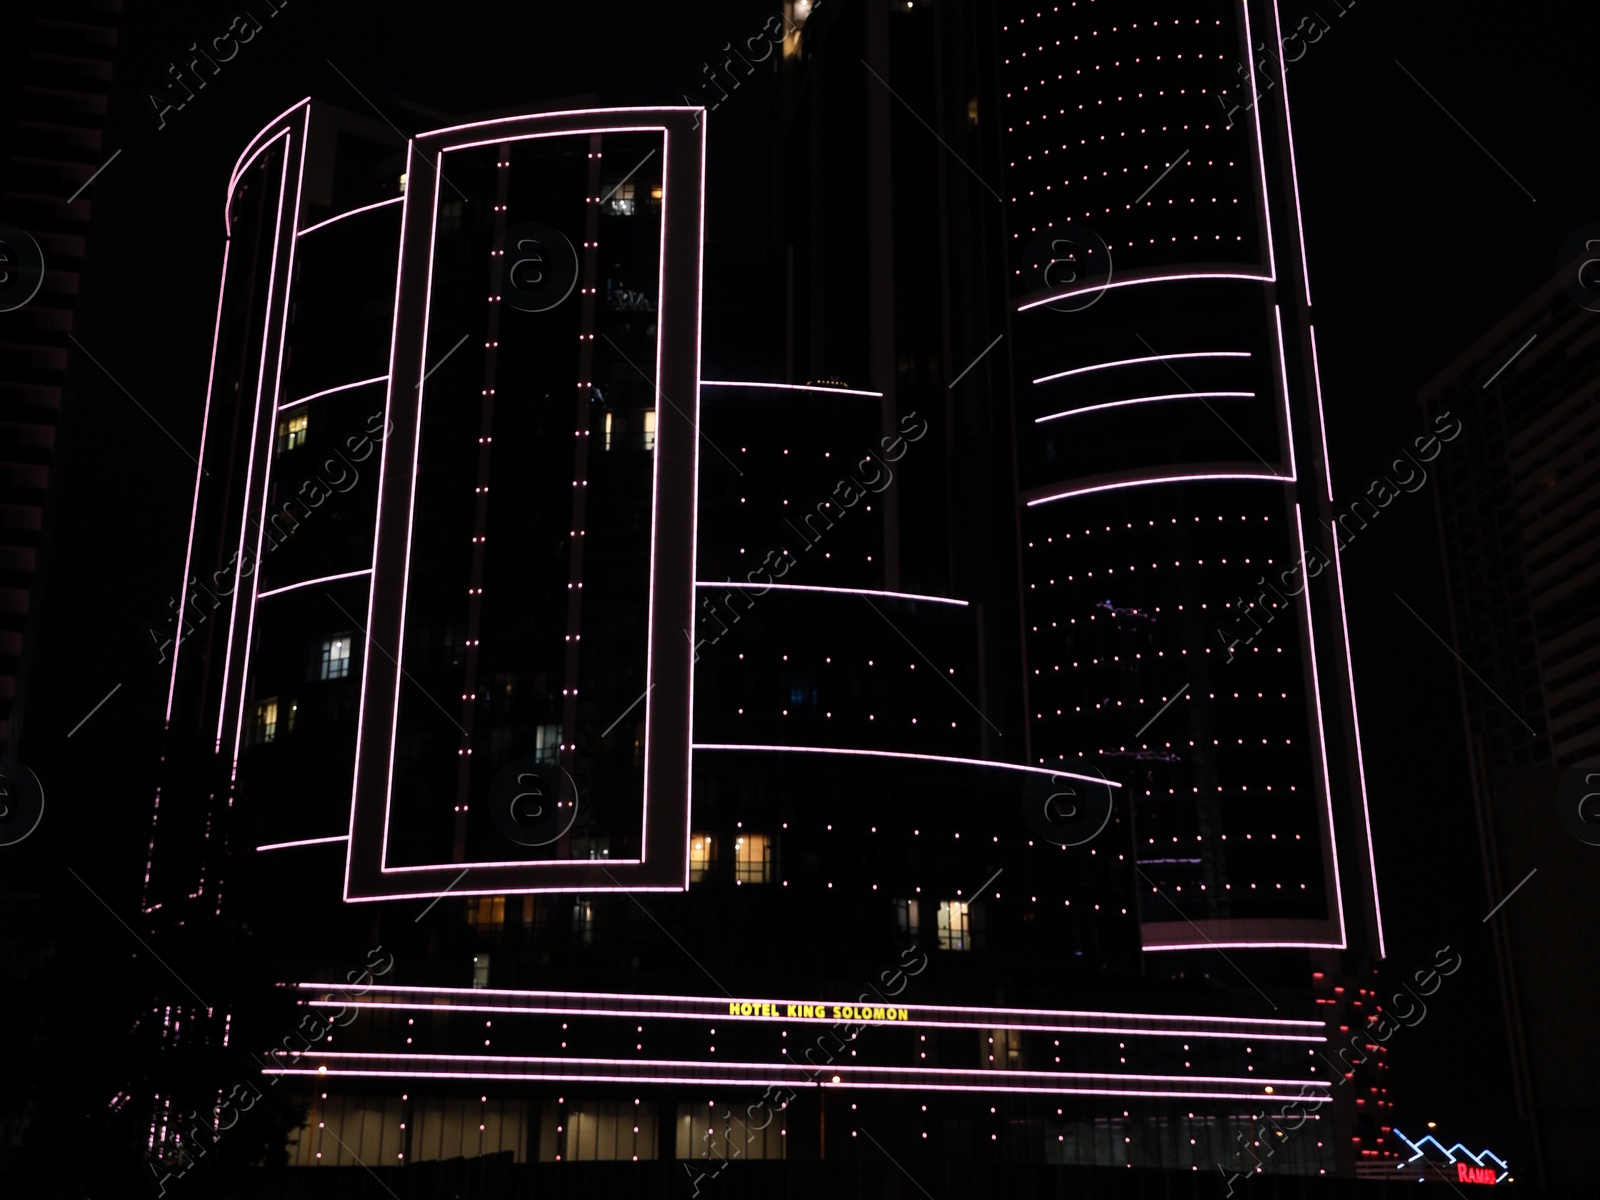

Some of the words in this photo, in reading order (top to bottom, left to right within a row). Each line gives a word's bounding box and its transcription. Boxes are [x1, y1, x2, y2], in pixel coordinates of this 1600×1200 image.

[729, 1002, 779, 1017] HOTEL
[787, 1005, 826, 1019] KING
[833, 1006, 909, 1021] SOLOMON
